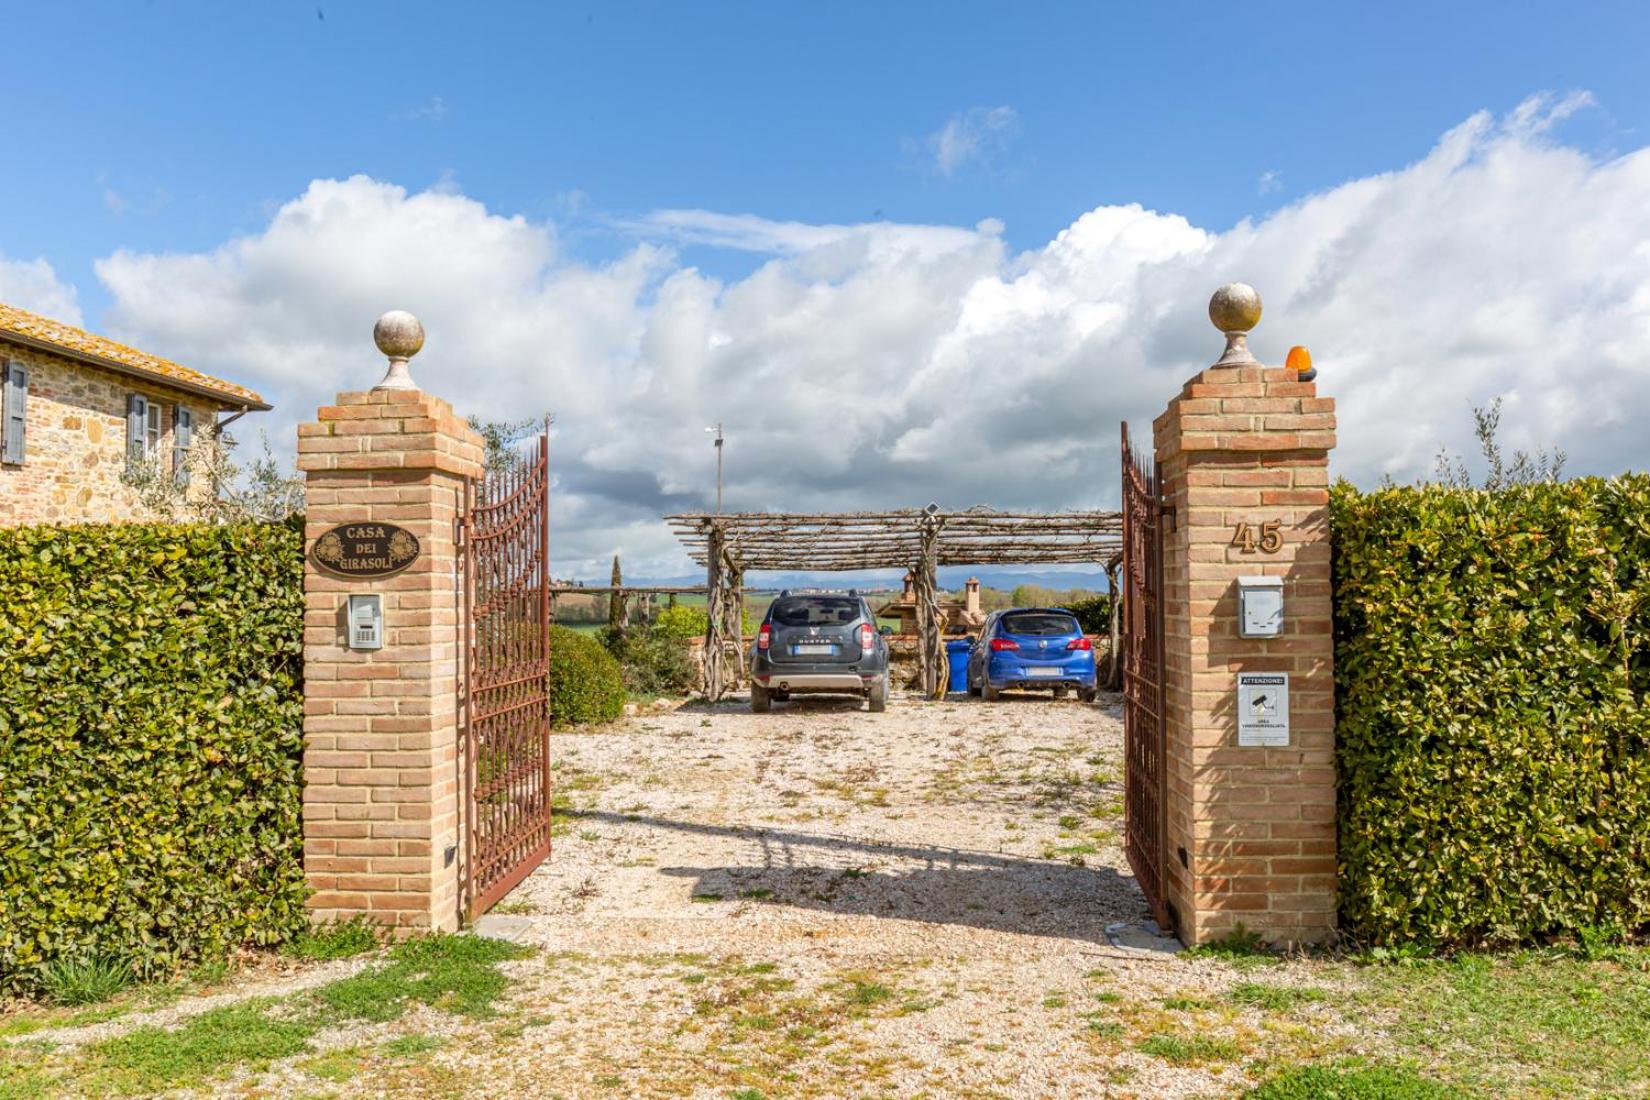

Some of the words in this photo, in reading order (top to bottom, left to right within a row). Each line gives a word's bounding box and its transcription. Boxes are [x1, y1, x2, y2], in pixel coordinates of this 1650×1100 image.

[346, 527, 386, 539] CASA
[1232, 519, 1283, 554] 45
[356, 544, 377, 554] DEI
[339, 557, 393, 570] GIRASOLI
